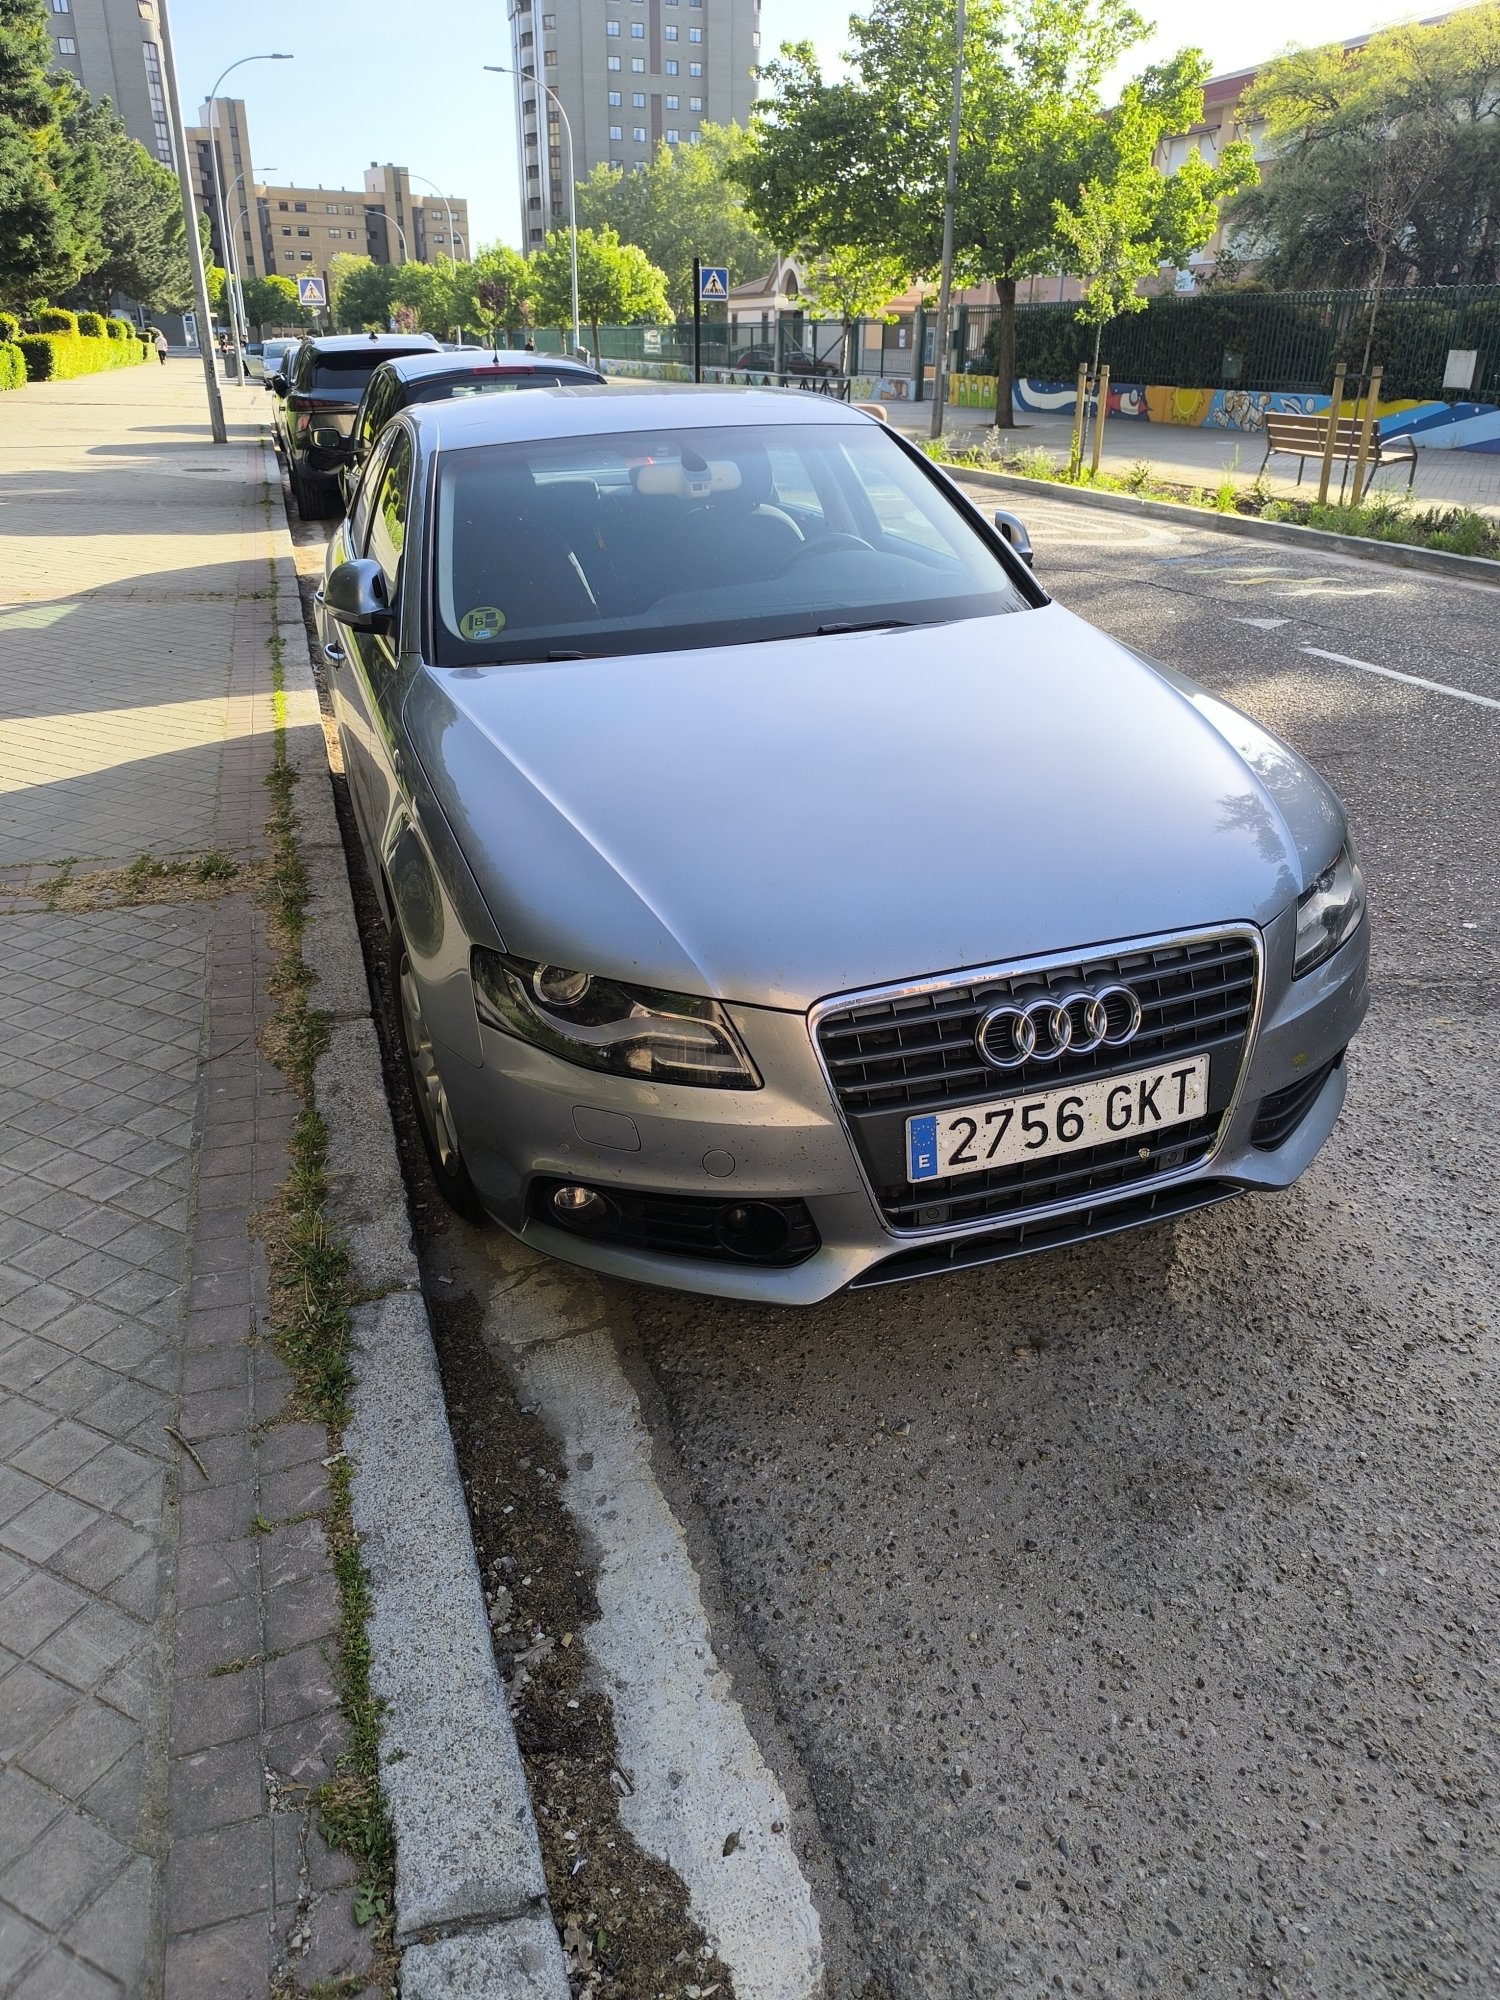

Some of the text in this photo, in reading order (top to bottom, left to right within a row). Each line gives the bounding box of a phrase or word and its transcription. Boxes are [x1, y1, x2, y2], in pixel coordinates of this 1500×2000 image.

[475, 618, 483, 626] B
[918, 1066, 1196, 1168] E 2756 GKT
